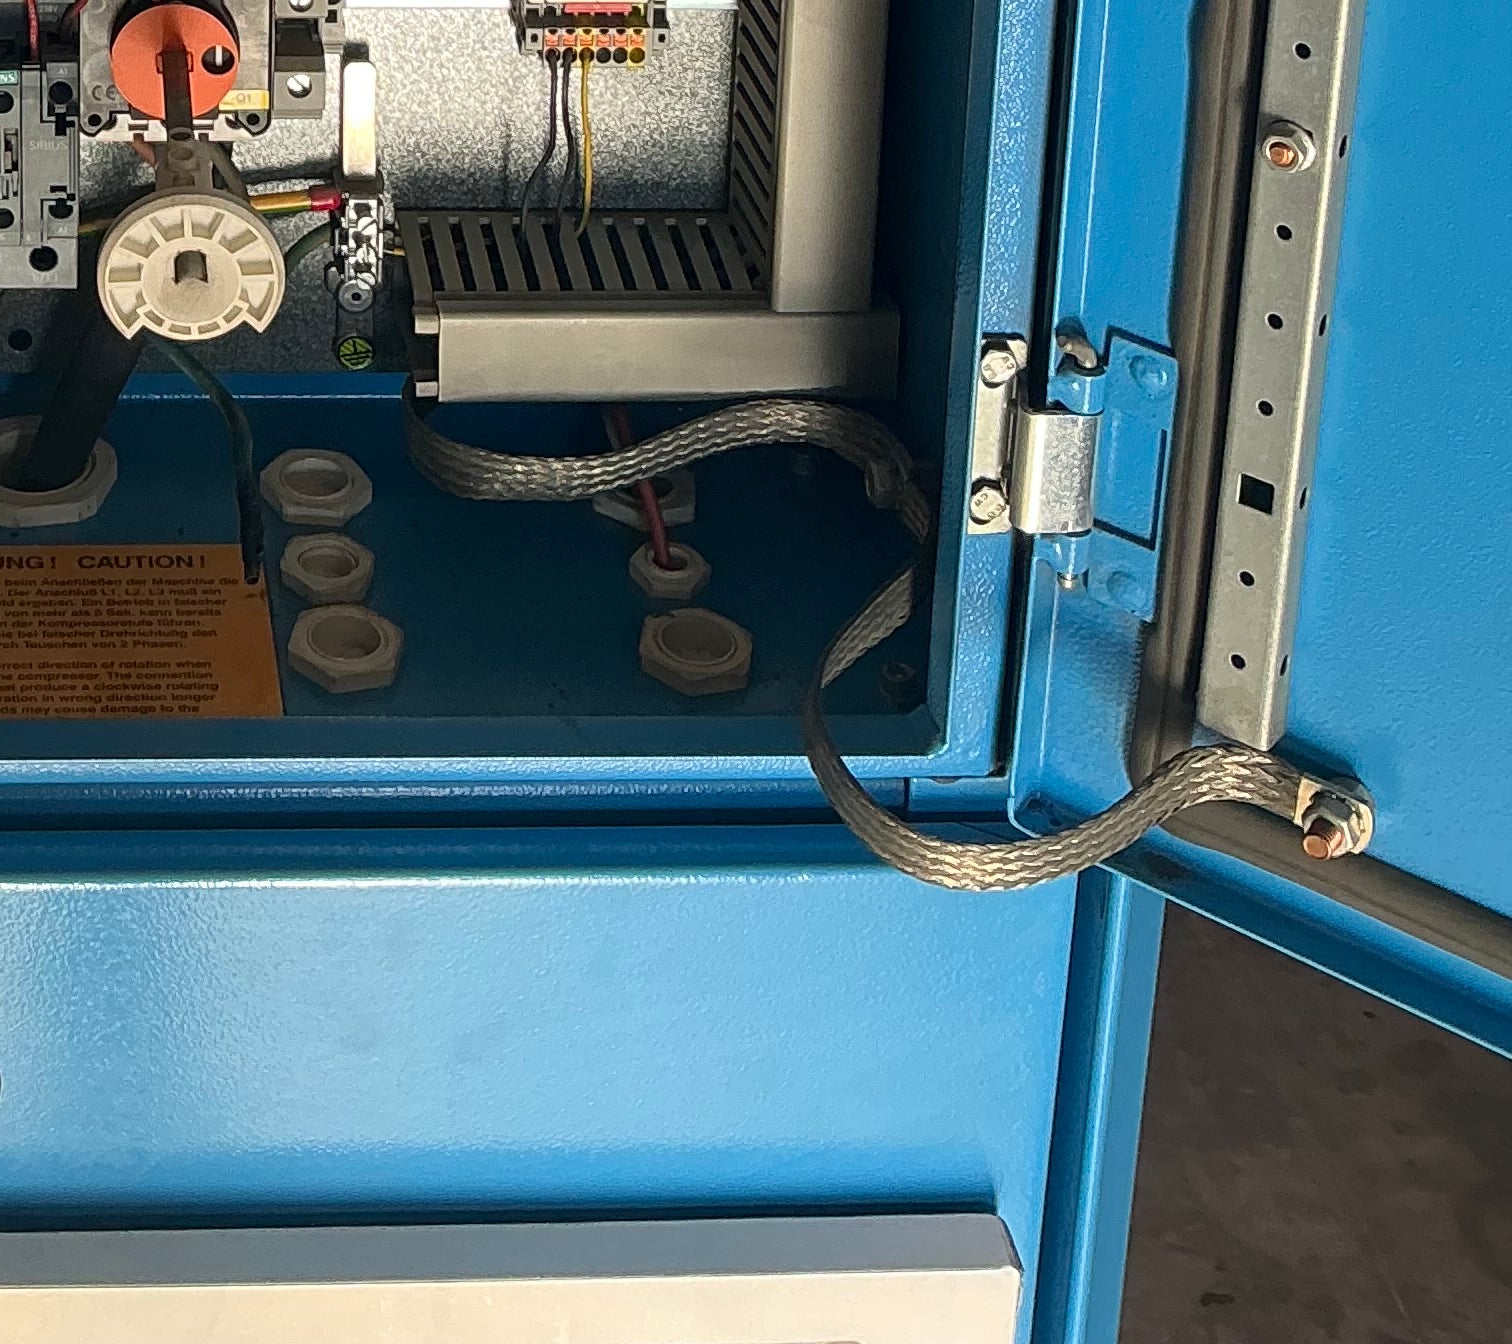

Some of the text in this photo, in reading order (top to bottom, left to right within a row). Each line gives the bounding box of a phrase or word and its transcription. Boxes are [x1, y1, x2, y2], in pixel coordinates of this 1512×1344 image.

[38, 661, 97, 669] direction
[101, 661, 115, 669] of
[108, 672, 132, 680] The
[20, 684, 77, 692] produce
[42, 694, 54, 702] in
[22, 706, 49, 715] may
[101, 704, 156, 714] damage
[160, 704, 173, 713] to
[178, 704, 199, 713] the
